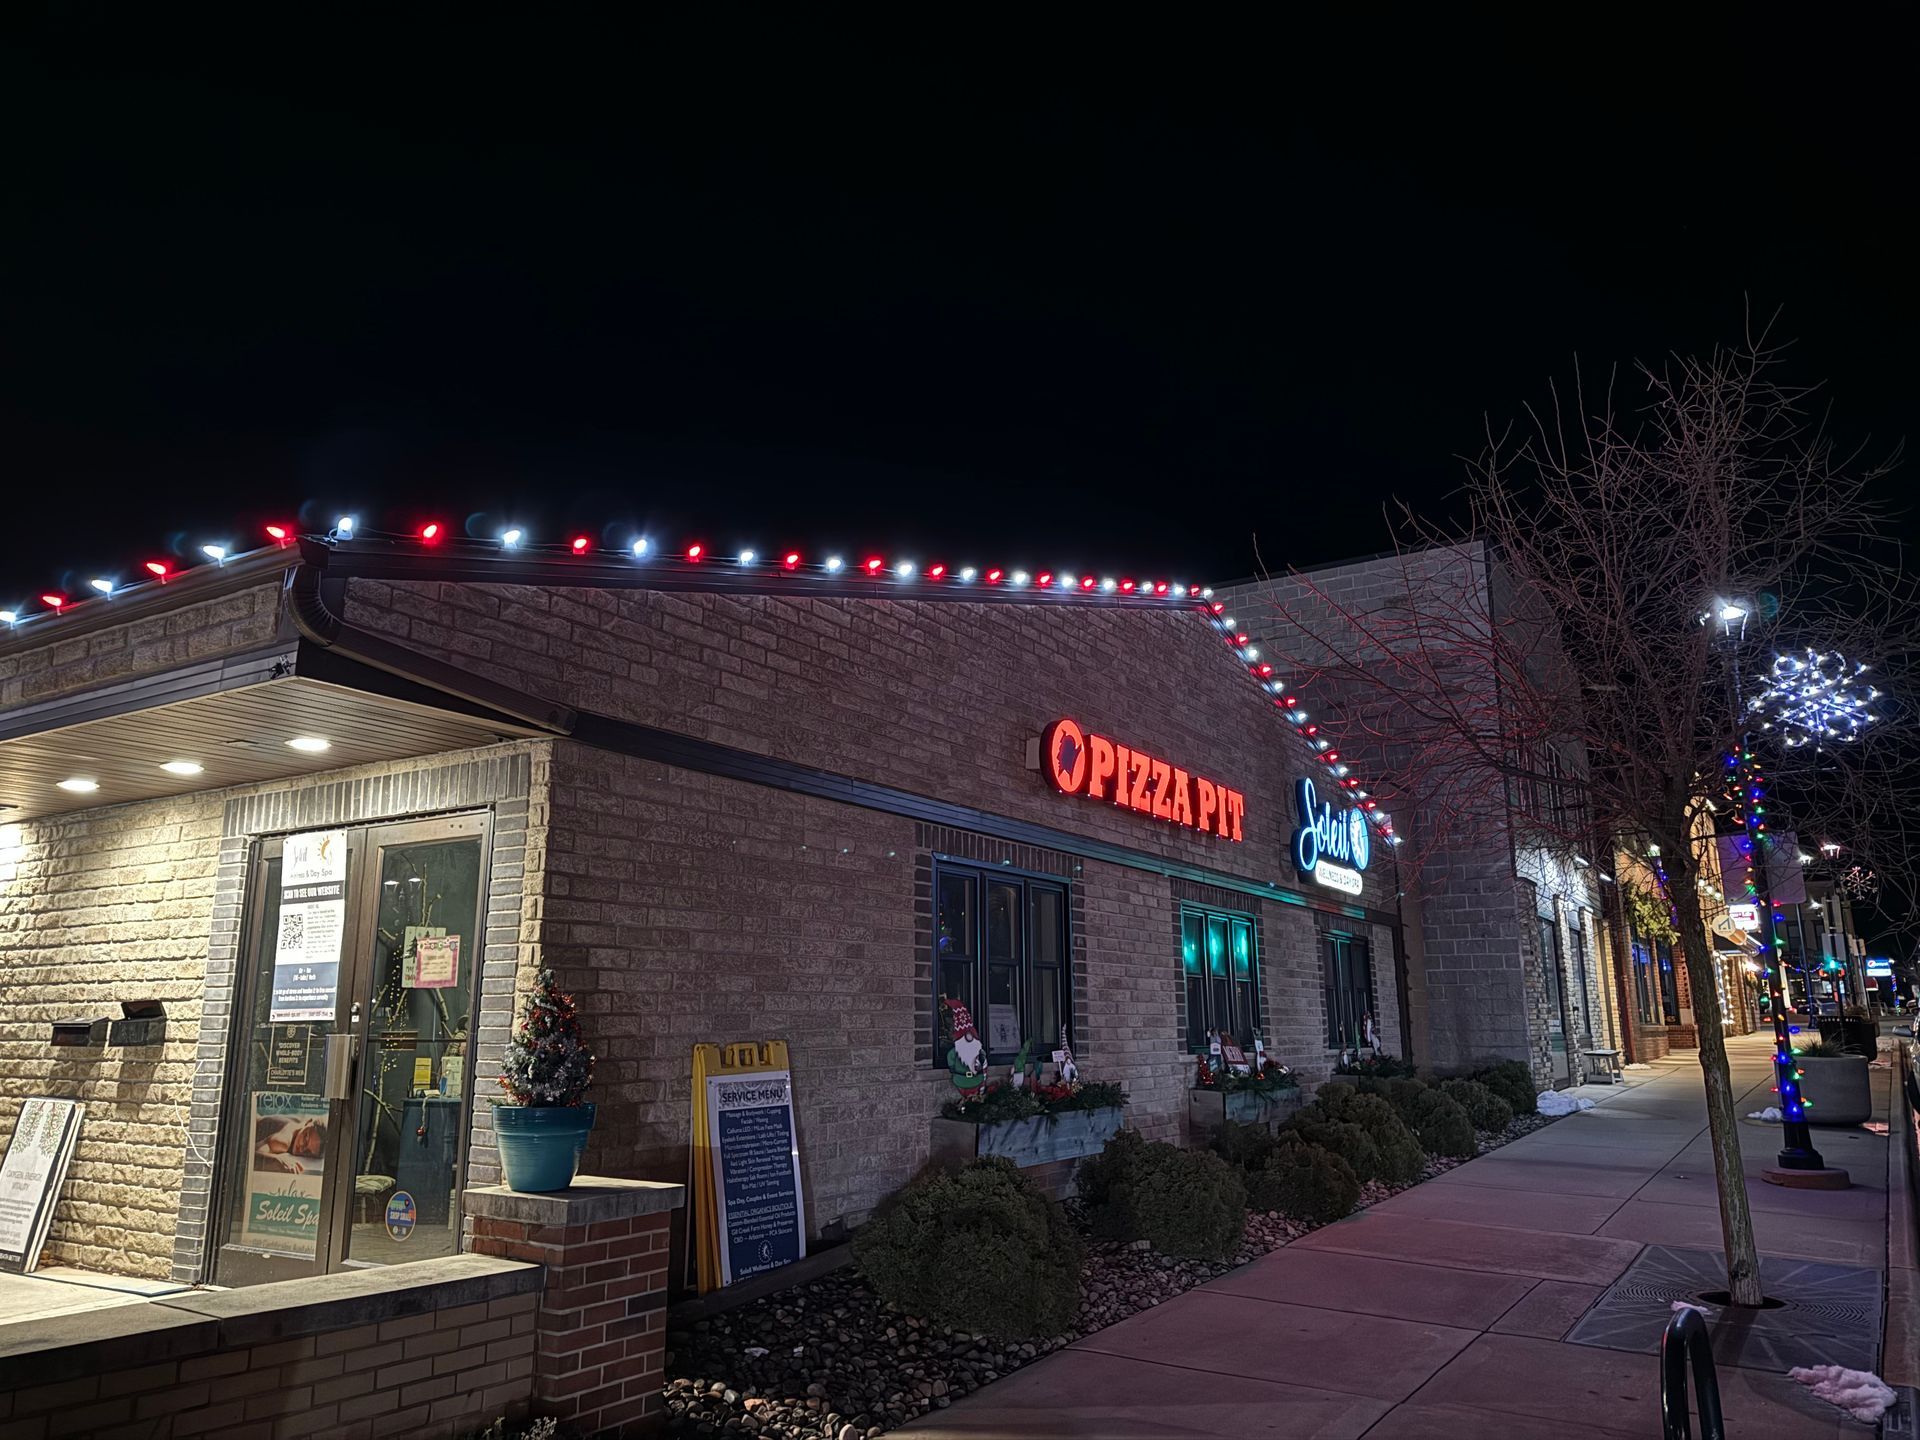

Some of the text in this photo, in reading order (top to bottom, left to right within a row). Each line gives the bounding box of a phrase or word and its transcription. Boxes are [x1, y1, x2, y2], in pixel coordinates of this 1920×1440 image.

[1089, 734, 1244, 842] PIZZA PIT
[1299, 777, 1350, 871] Soleil
[310, 869, 320, 878] Day
[321, 868, 333, 877] Spa
[317, 885, 340, 896] WEBSITE
[260, 1093, 293, 1109] relax
[722, 1089, 783, 1103] SERVICE MENU
[773, 1162, 788, 1170] Therapy
[745, 1195, 762, 1203] Couples
[256, 1200, 294, 1222] Soleil
[294, 1203, 320, 1231] Spa
[780, 1210, 796, 1218] Products
[760, 1223, 773, 1231] Honey
[733, 1236, 744, 1244] CBD
[752, 1263, 770, 1271] Wellness
